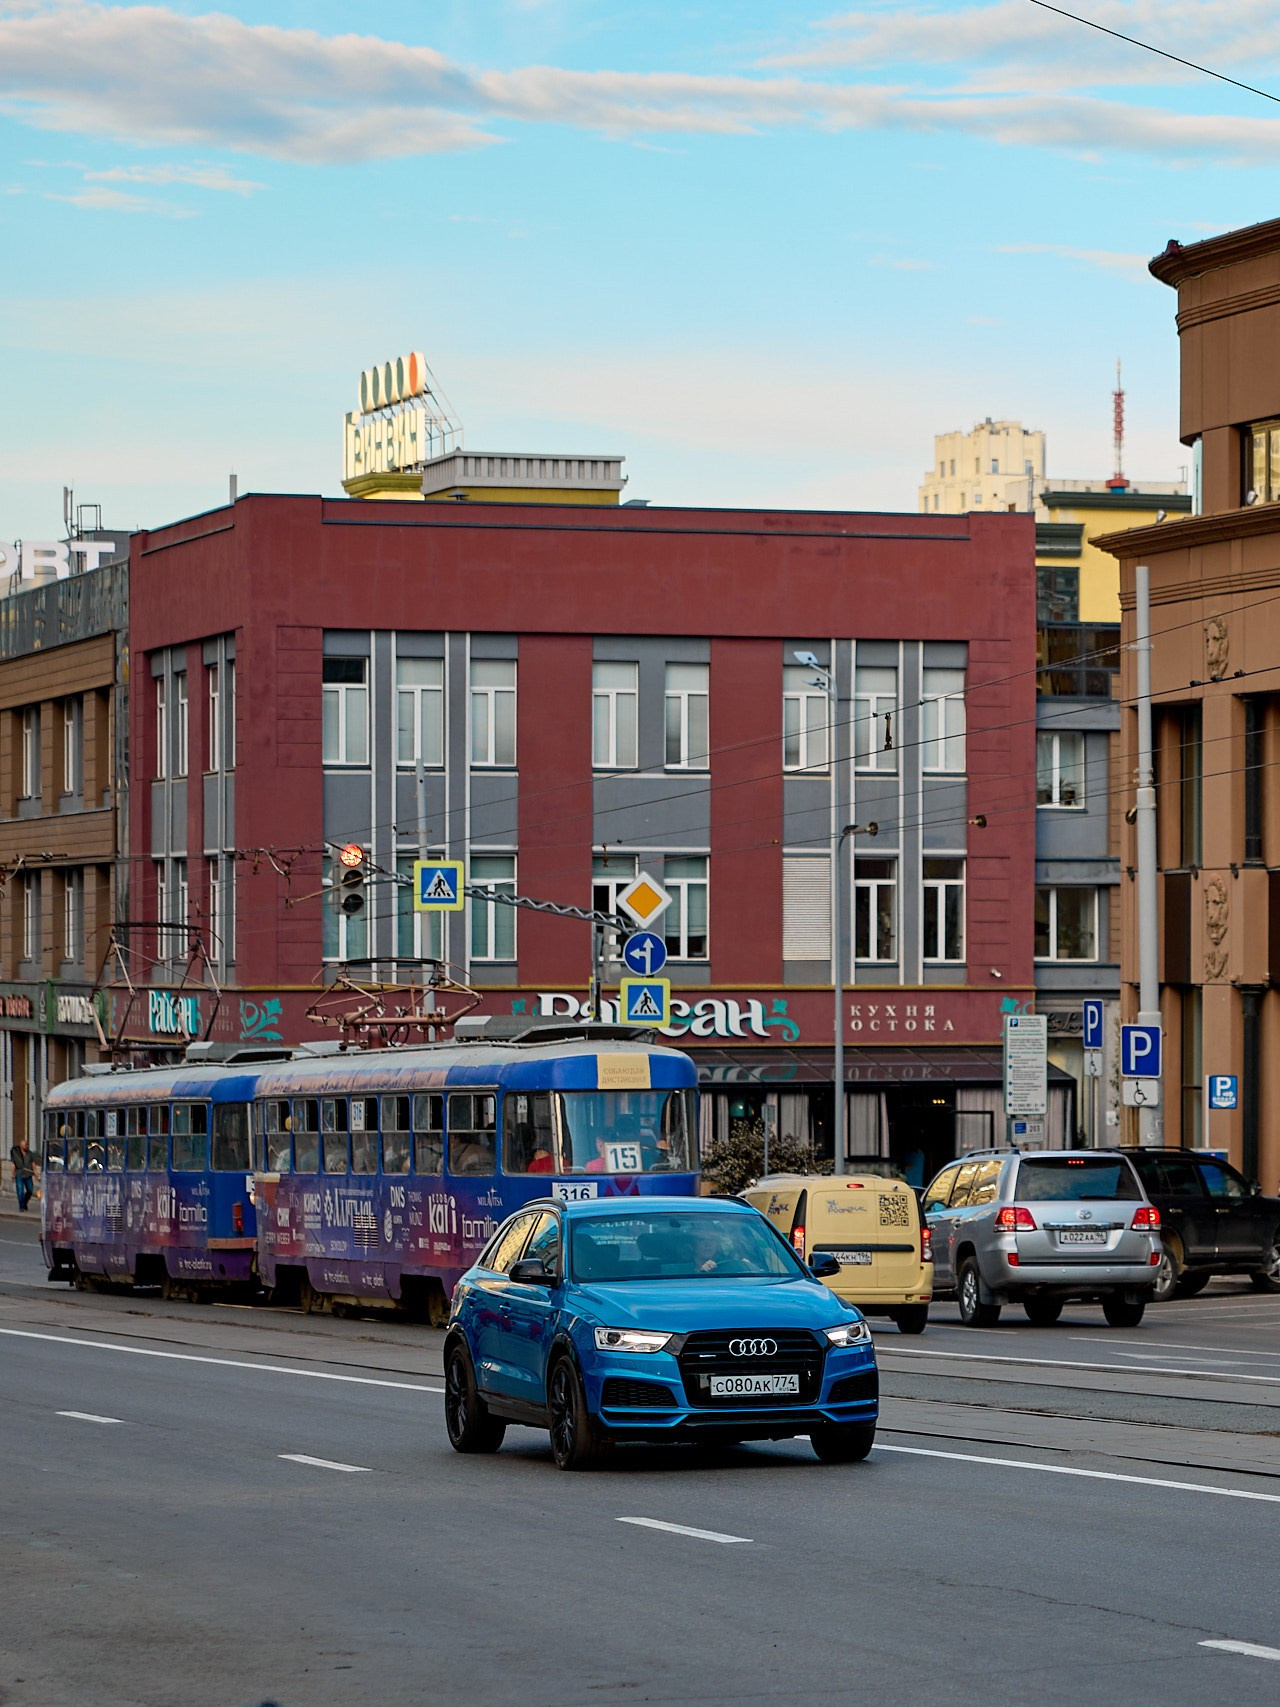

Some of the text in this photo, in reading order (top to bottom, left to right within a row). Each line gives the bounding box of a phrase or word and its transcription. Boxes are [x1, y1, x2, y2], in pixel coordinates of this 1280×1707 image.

[850, 1005, 935, 1017] КУХНЯ
[834, 1019, 955, 1031] ОСТОКА
[1129, 1031, 1152, 1071] P
[610, 1147, 638, 1169] 15
[390, 1185, 406, 1208] DNS
[559, 1188, 590, 1200] 316
[428, 1195, 457, 1234] kari
